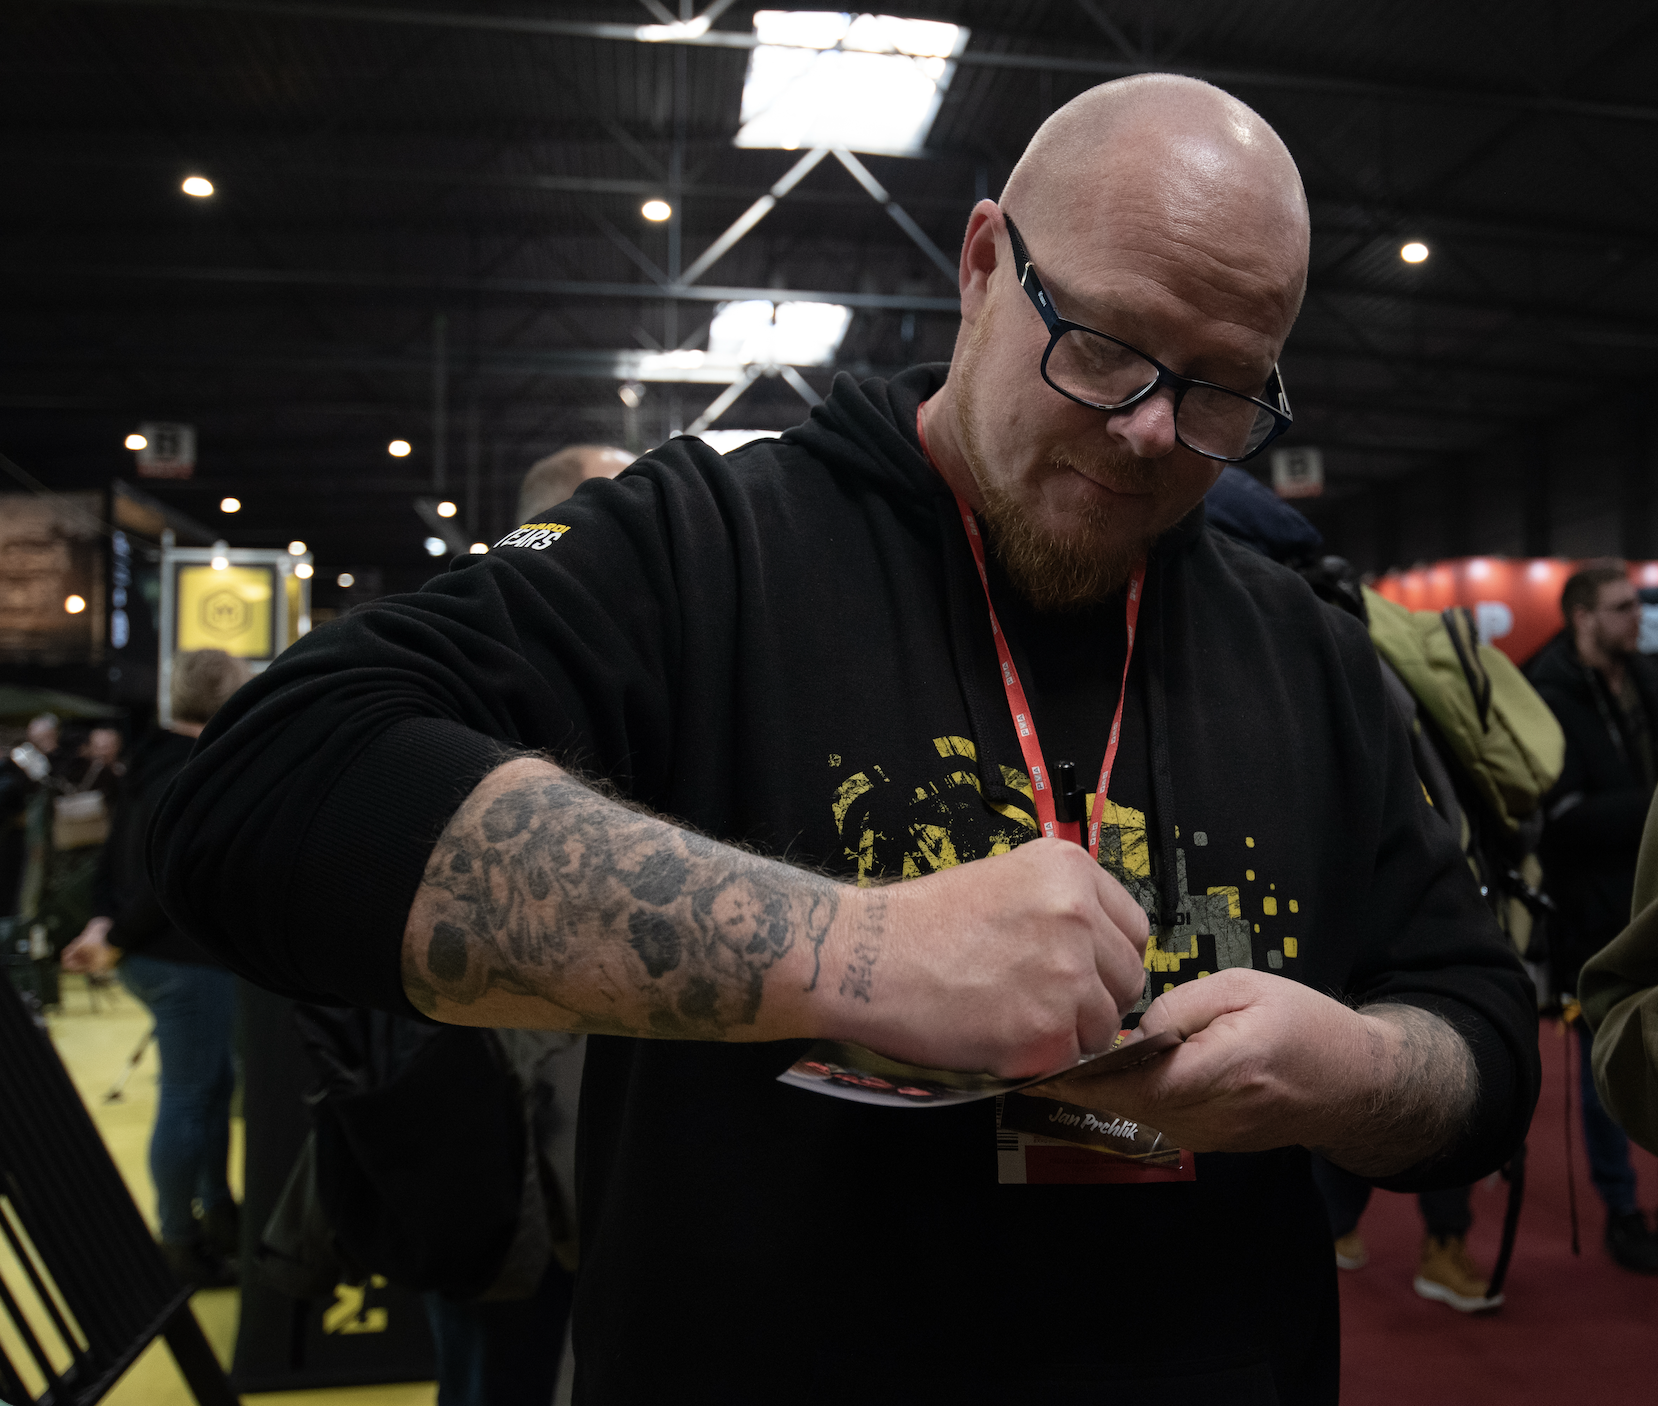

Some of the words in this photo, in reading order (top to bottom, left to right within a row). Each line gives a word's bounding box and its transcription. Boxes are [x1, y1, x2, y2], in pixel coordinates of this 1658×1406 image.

[1016, 713, 1030, 737] PVA
[1031, 766, 1045, 791] PVA
[1044, 821, 1055, 838] VA
[1048, 1106, 1081, 1127] Jan
